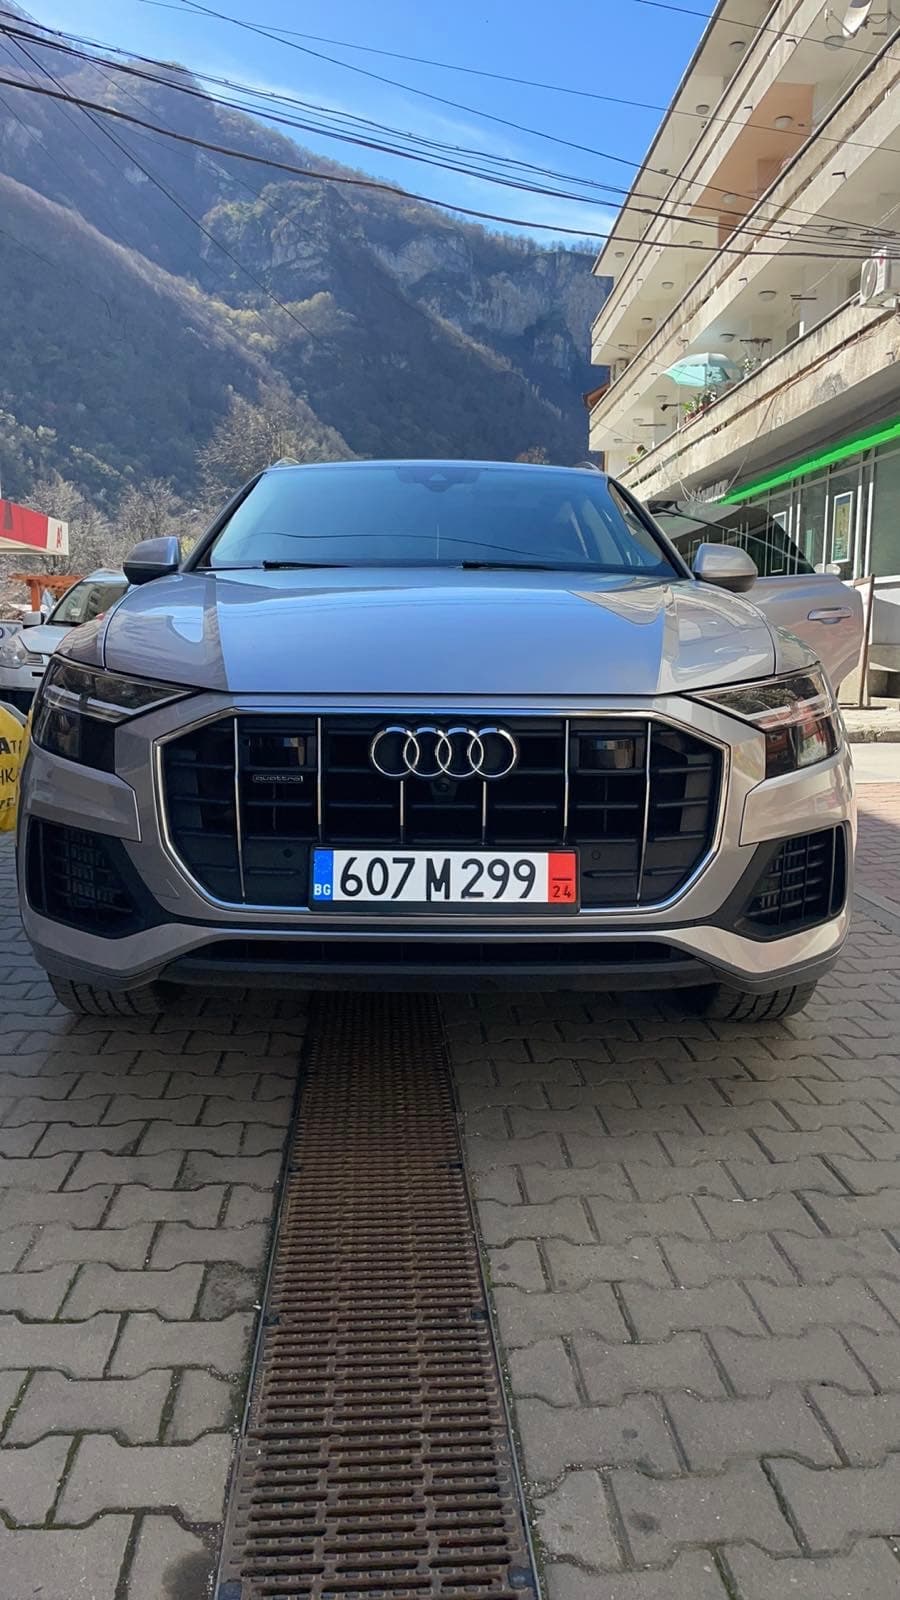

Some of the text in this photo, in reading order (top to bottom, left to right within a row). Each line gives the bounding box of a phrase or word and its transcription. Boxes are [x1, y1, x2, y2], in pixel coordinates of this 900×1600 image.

[340, 857, 536, 901] 607 M 299
[314, 884, 331, 896] BG
[552, 886, 572, 898] 24
